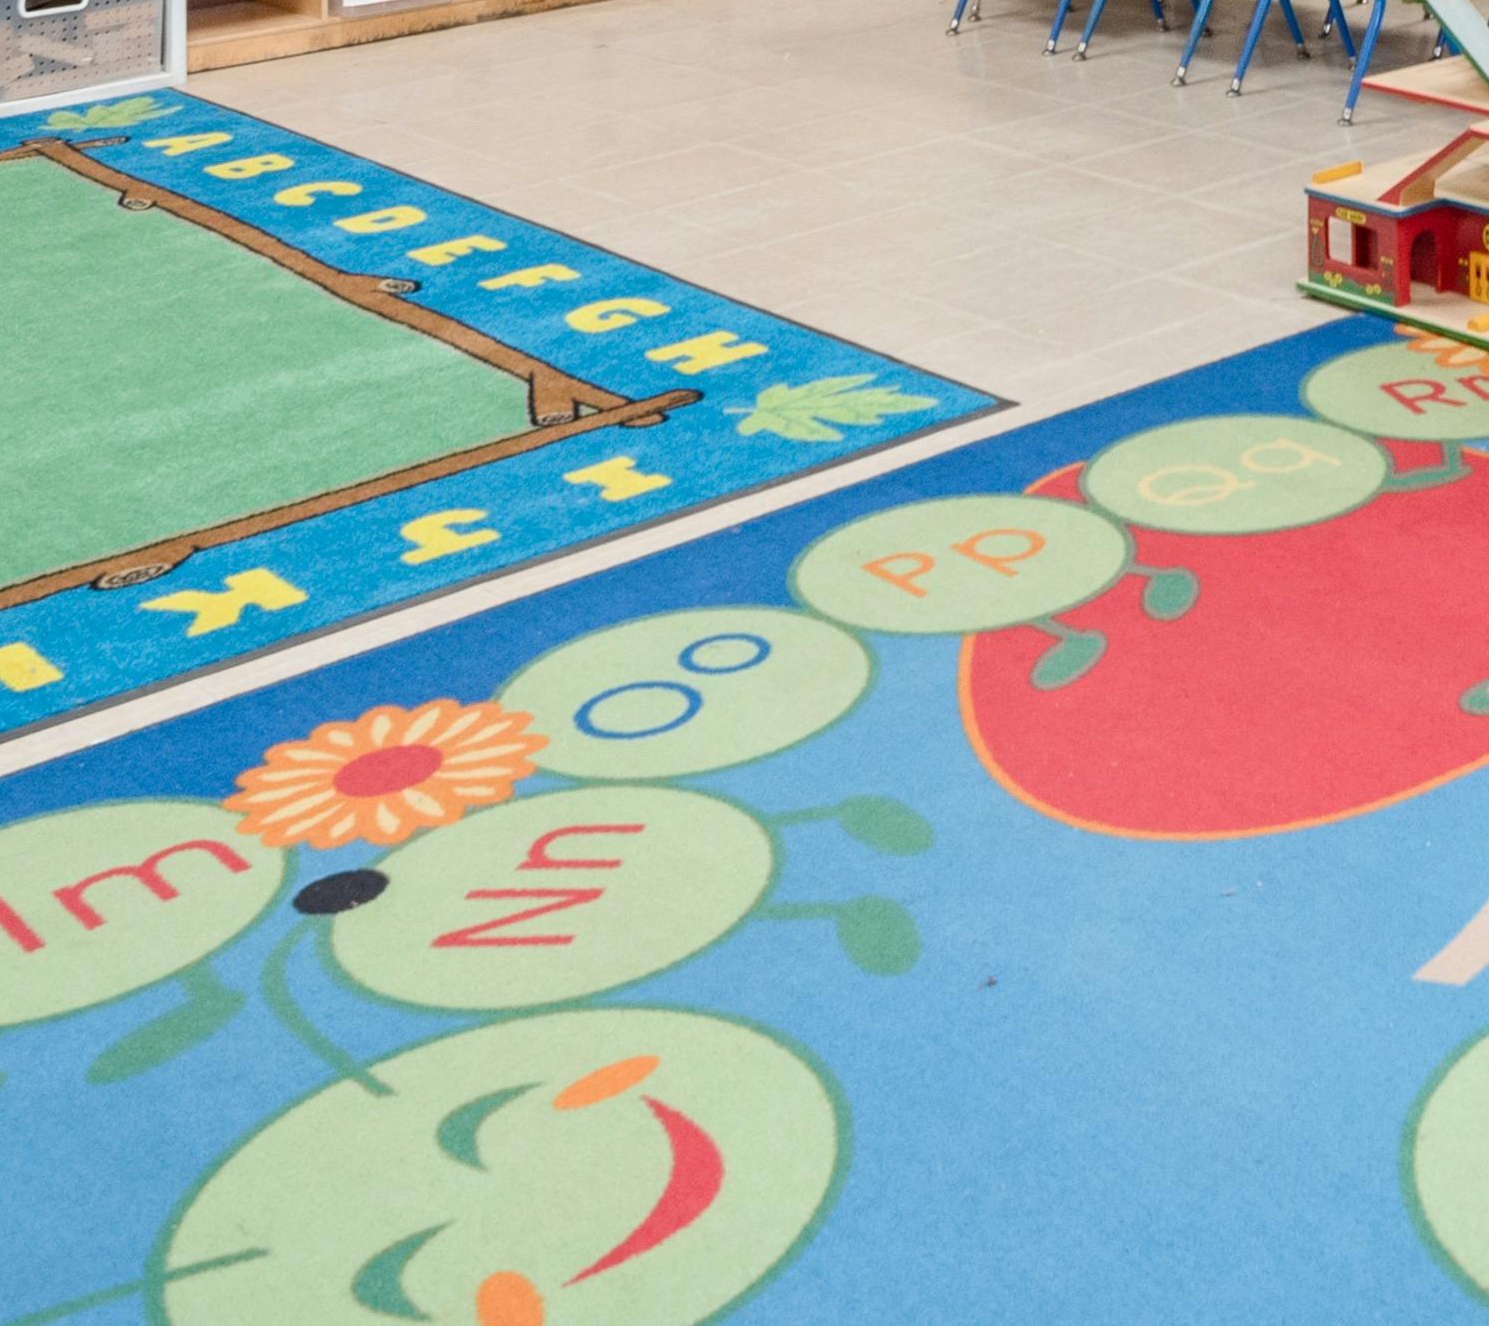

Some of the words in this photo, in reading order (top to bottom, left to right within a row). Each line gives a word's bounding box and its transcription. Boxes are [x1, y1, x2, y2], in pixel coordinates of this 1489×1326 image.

[143, 132, 234, 156] A
[203, 153, 295, 179] B
[273, 181, 363, 206] C
[333, 206, 428, 233] D
[406, 235, 507, 266] E
[478, 263, 582, 291] F
[564, 298, 672, 333] G
[644, 330, 770, 376] H
[1136, 433, 1344, 508] Qq
[398, 507, 502, 566] J
[860, 523, 1048, 600] Pp
[137, 565, 309, 637] K
[429, 822, 647, 950] Nn
